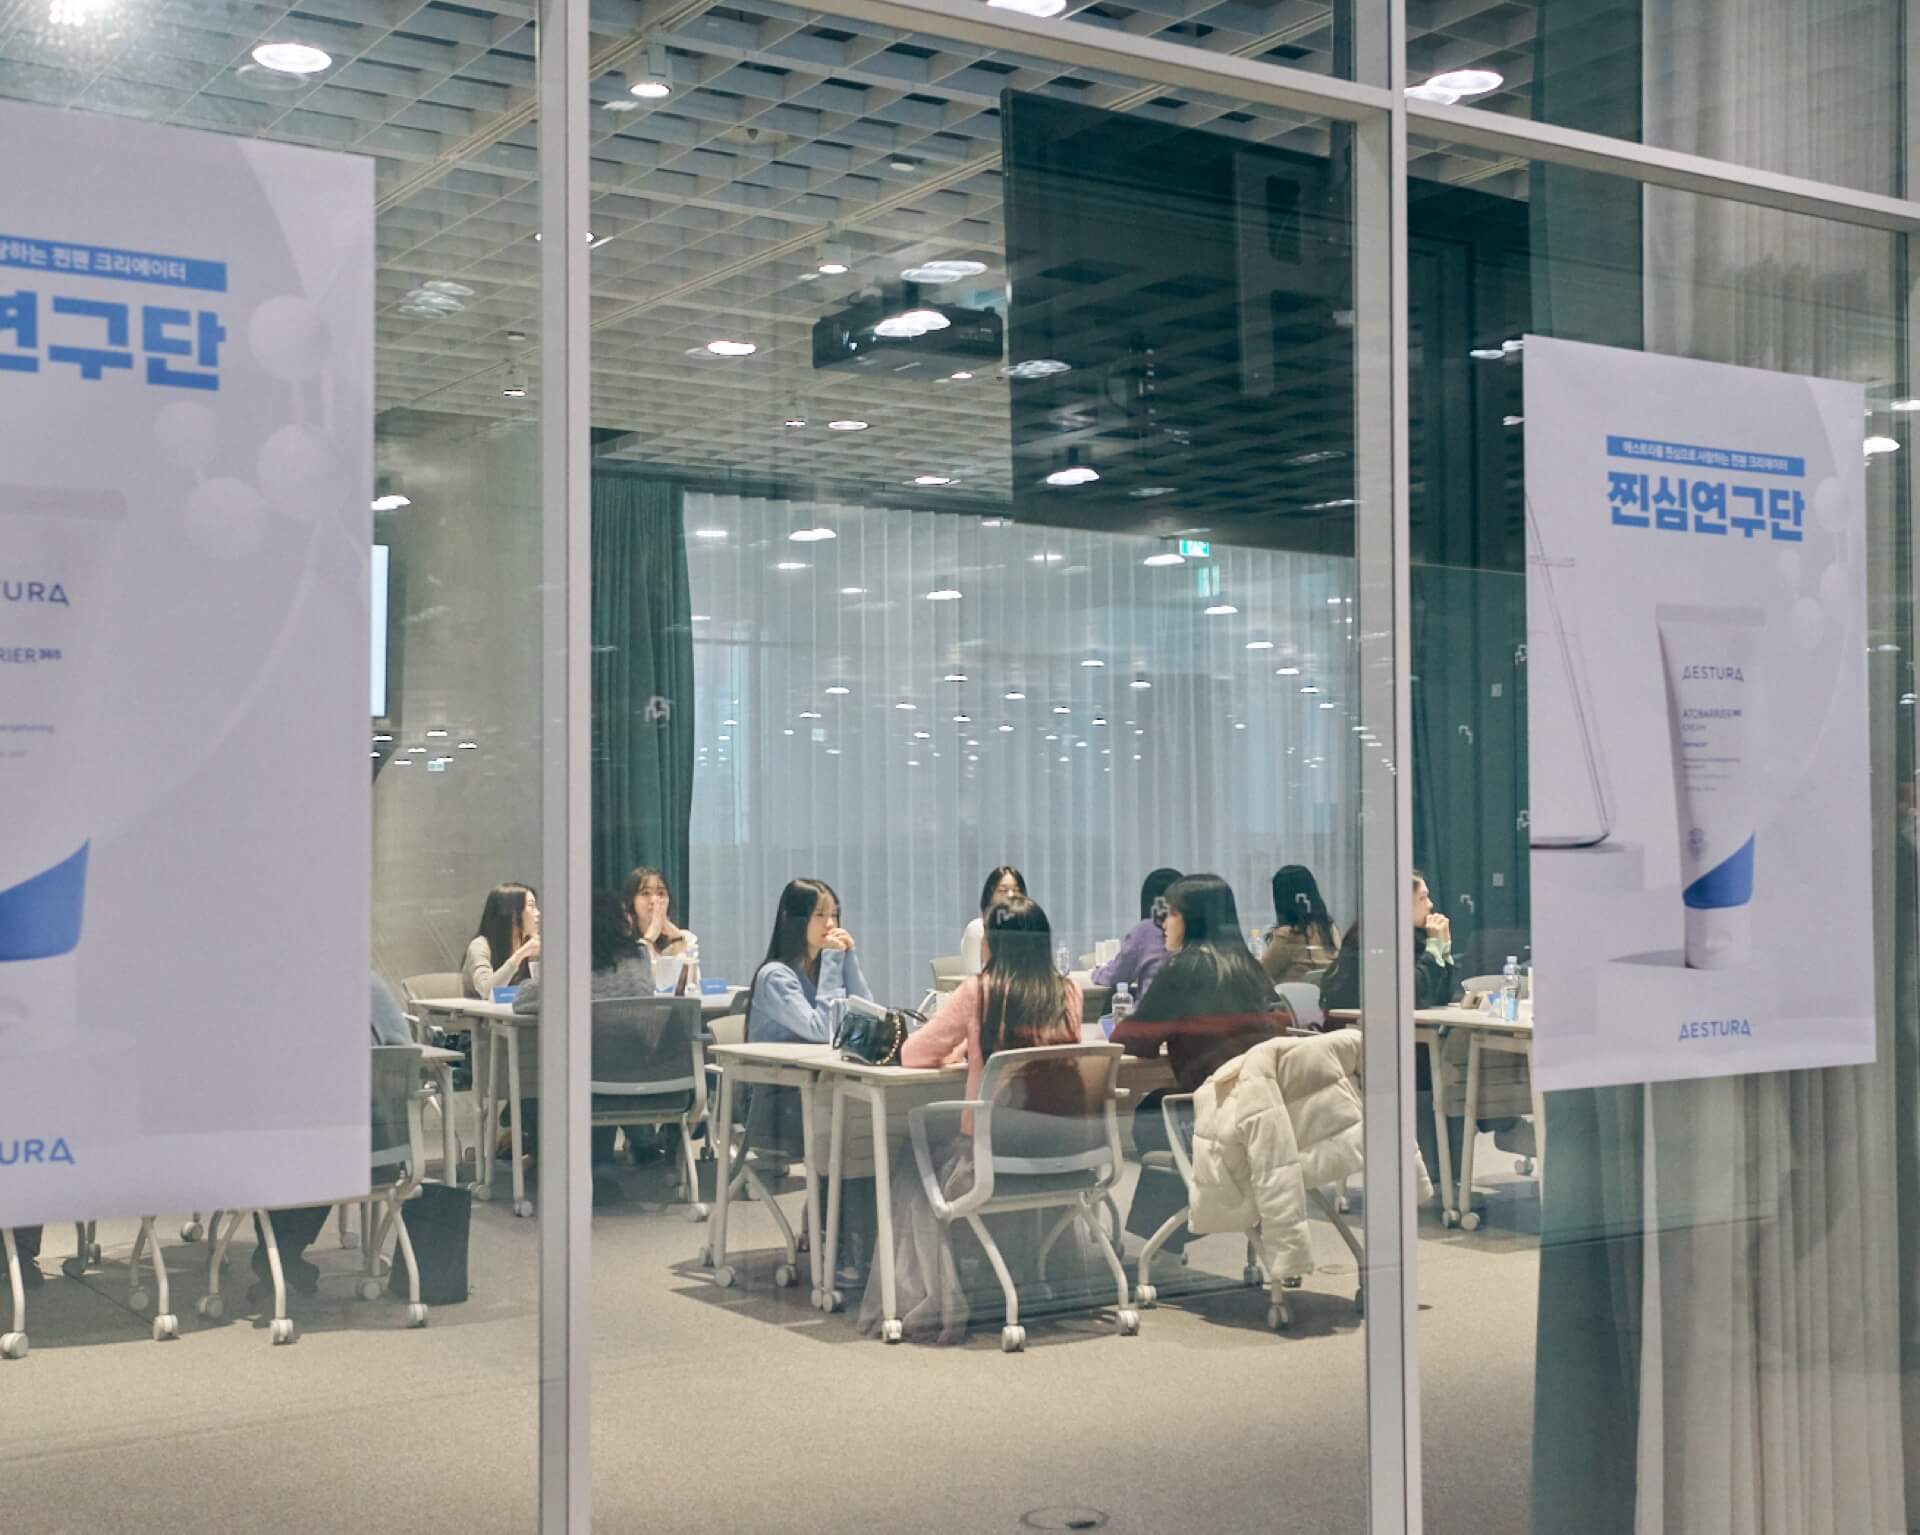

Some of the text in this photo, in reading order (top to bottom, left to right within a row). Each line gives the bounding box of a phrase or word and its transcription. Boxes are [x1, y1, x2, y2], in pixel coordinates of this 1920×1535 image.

[95, 253, 187, 280] 크리에이터
[1607, 471, 1805, 541] 찐심연구단
[0, 581, 70, 607] URA
[1682, 665, 1744, 682] AESTURA
[1679, 1019, 1751, 1040] AESTURA
